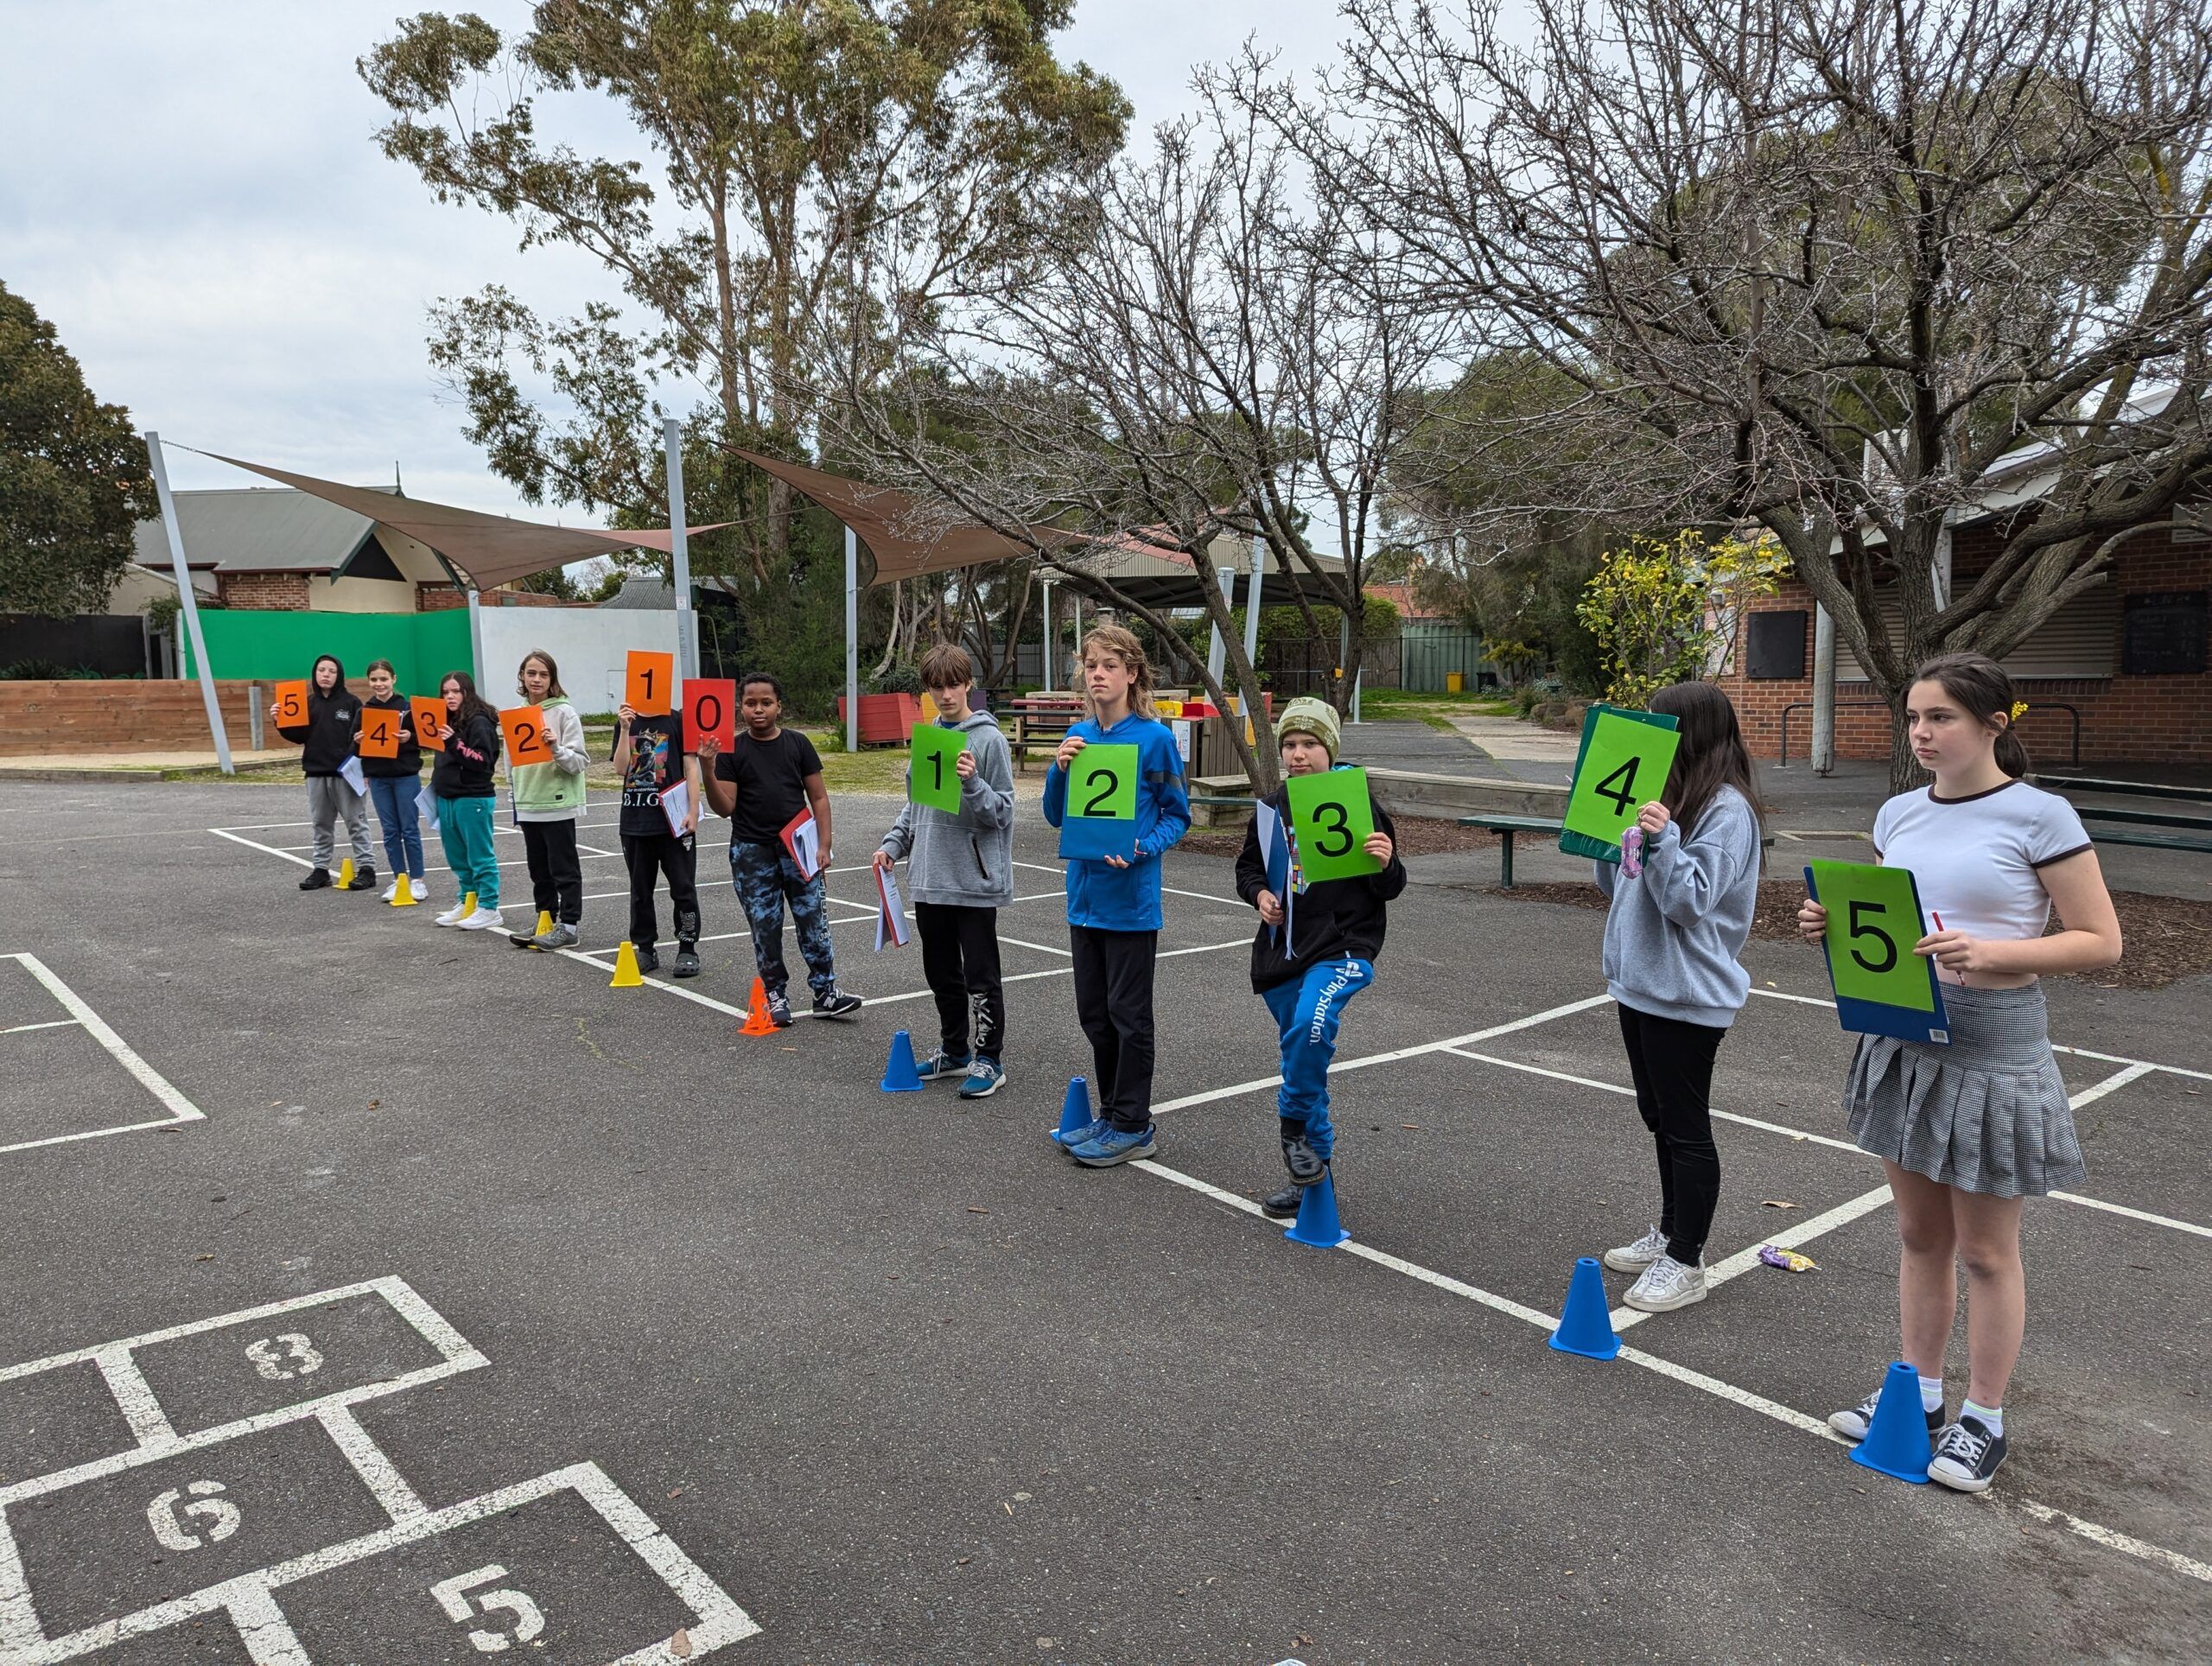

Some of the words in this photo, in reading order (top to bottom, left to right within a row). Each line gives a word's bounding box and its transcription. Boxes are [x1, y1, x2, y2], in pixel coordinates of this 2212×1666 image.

[283, 693, 299, 717] 5
[640, 668, 653, 700] 1
[370, 722, 389, 747] 4
[420, 711, 438, 738] 3
[514, 722, 539, 753] 2
[696, 695, 721, 732] 0
[926, 750, 942, 791] 1
[1084, 769, 1118, 817] 2
[1594, 756, 1641, 817] 4
[1312, 802, 1354, 858] 3
[1847, 900, 1898, 974] 5
[1309, 975, 1348, 1043] PlayStation
[245, 1332, 324, 1381] 8
[147, 1480, 241, 1551] 6
[430, 1564, 545, 1654] 5
